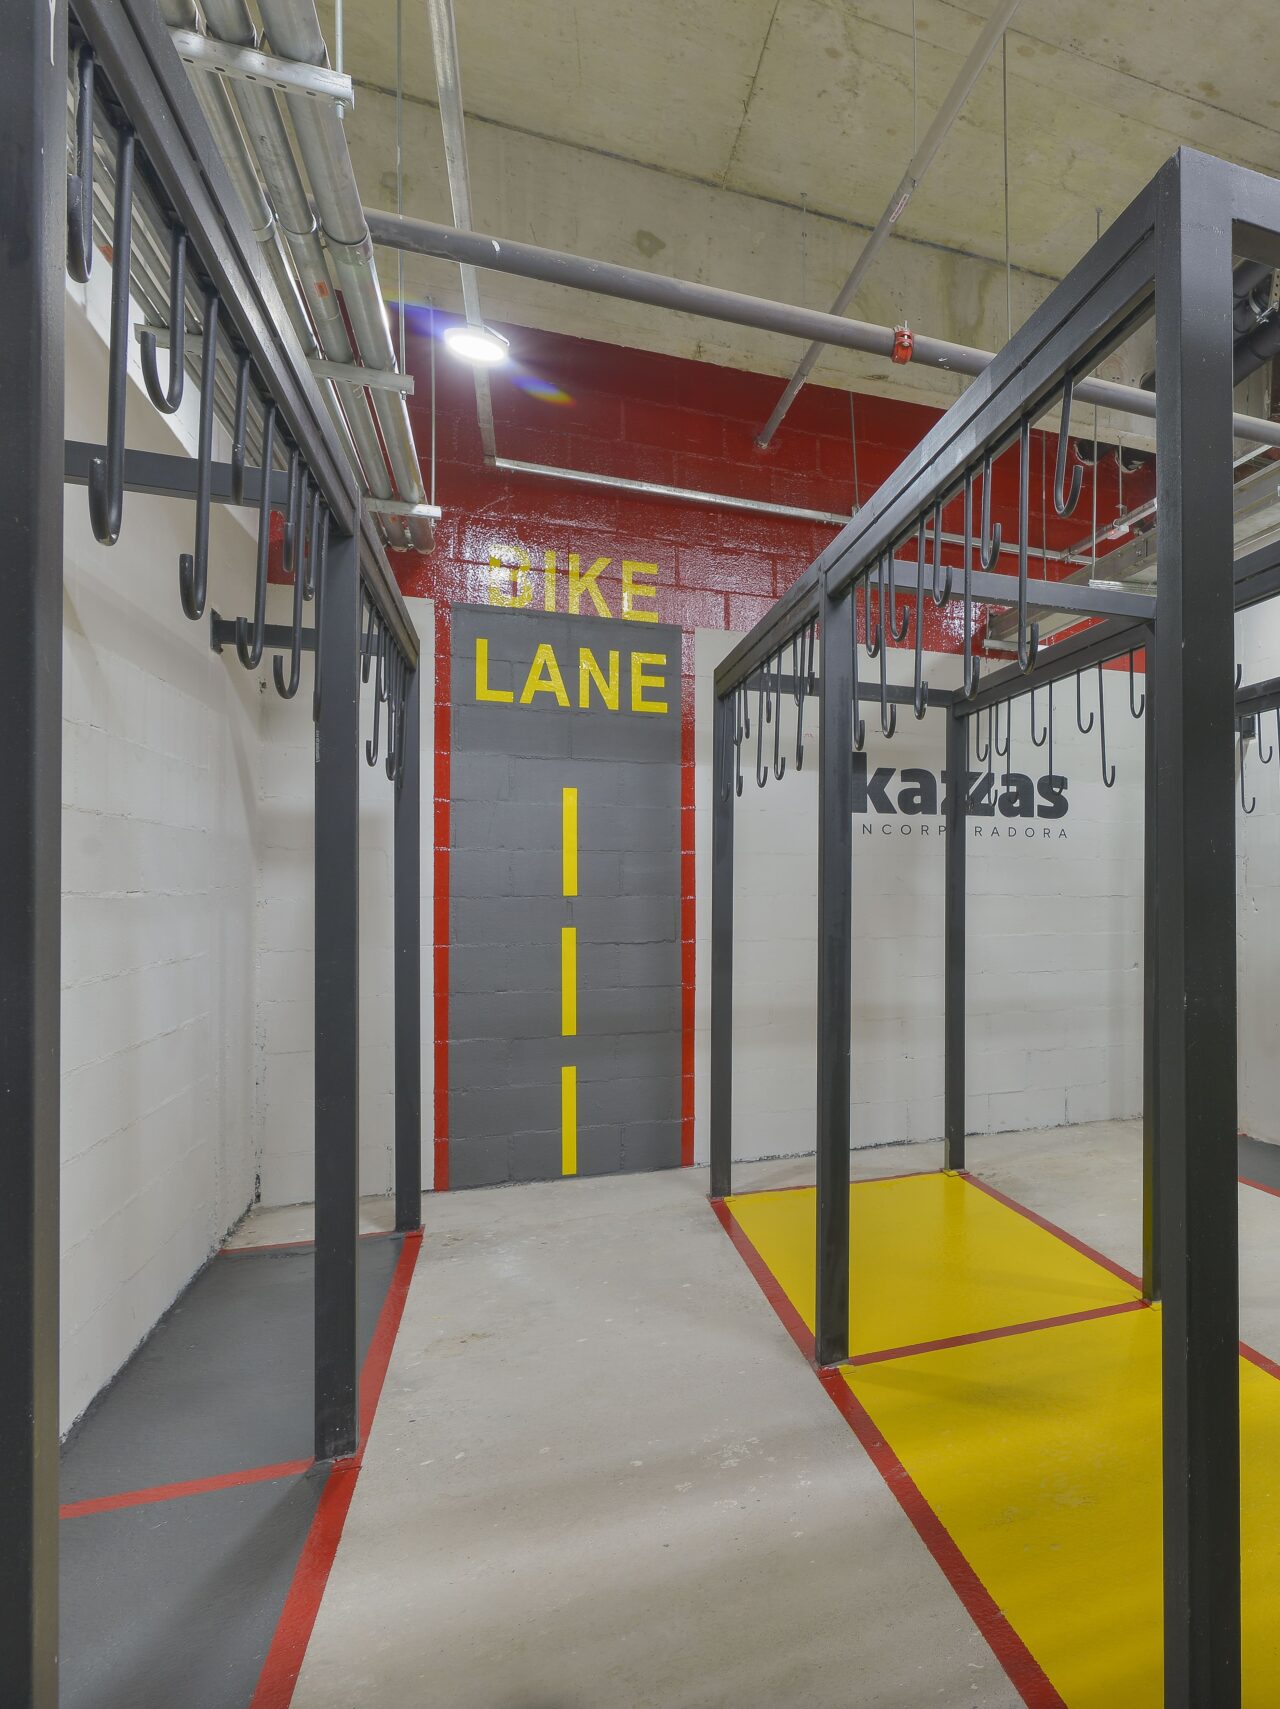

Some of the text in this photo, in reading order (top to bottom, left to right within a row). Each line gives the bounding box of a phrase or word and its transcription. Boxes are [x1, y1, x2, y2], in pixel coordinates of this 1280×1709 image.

[488, 544, 659, 623] BIKE
[475, 638, 668, 714] LANE
[862, 823, 1068, 839] NCORPRADORA
